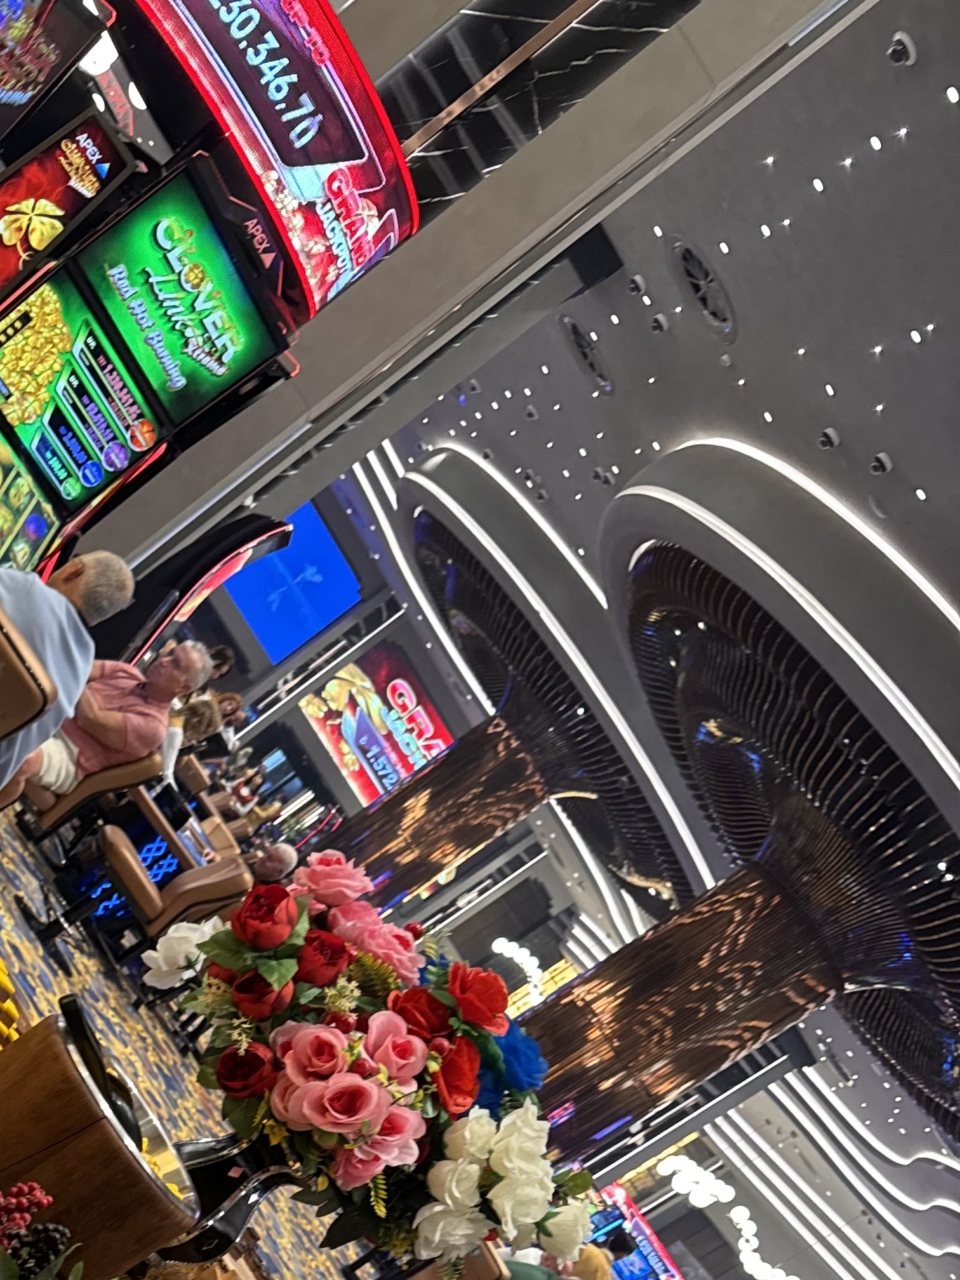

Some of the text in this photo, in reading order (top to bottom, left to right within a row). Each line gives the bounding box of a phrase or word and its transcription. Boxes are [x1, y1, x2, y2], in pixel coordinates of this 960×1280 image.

[76, 133, 102, 165] APEX
[243, 218, 271, 253] APEX
[325, 167, 377, 270] GRAND
[107, 264, 187, 391] Red Hot Burning
[155, 217, 245, 364] CLOVER
